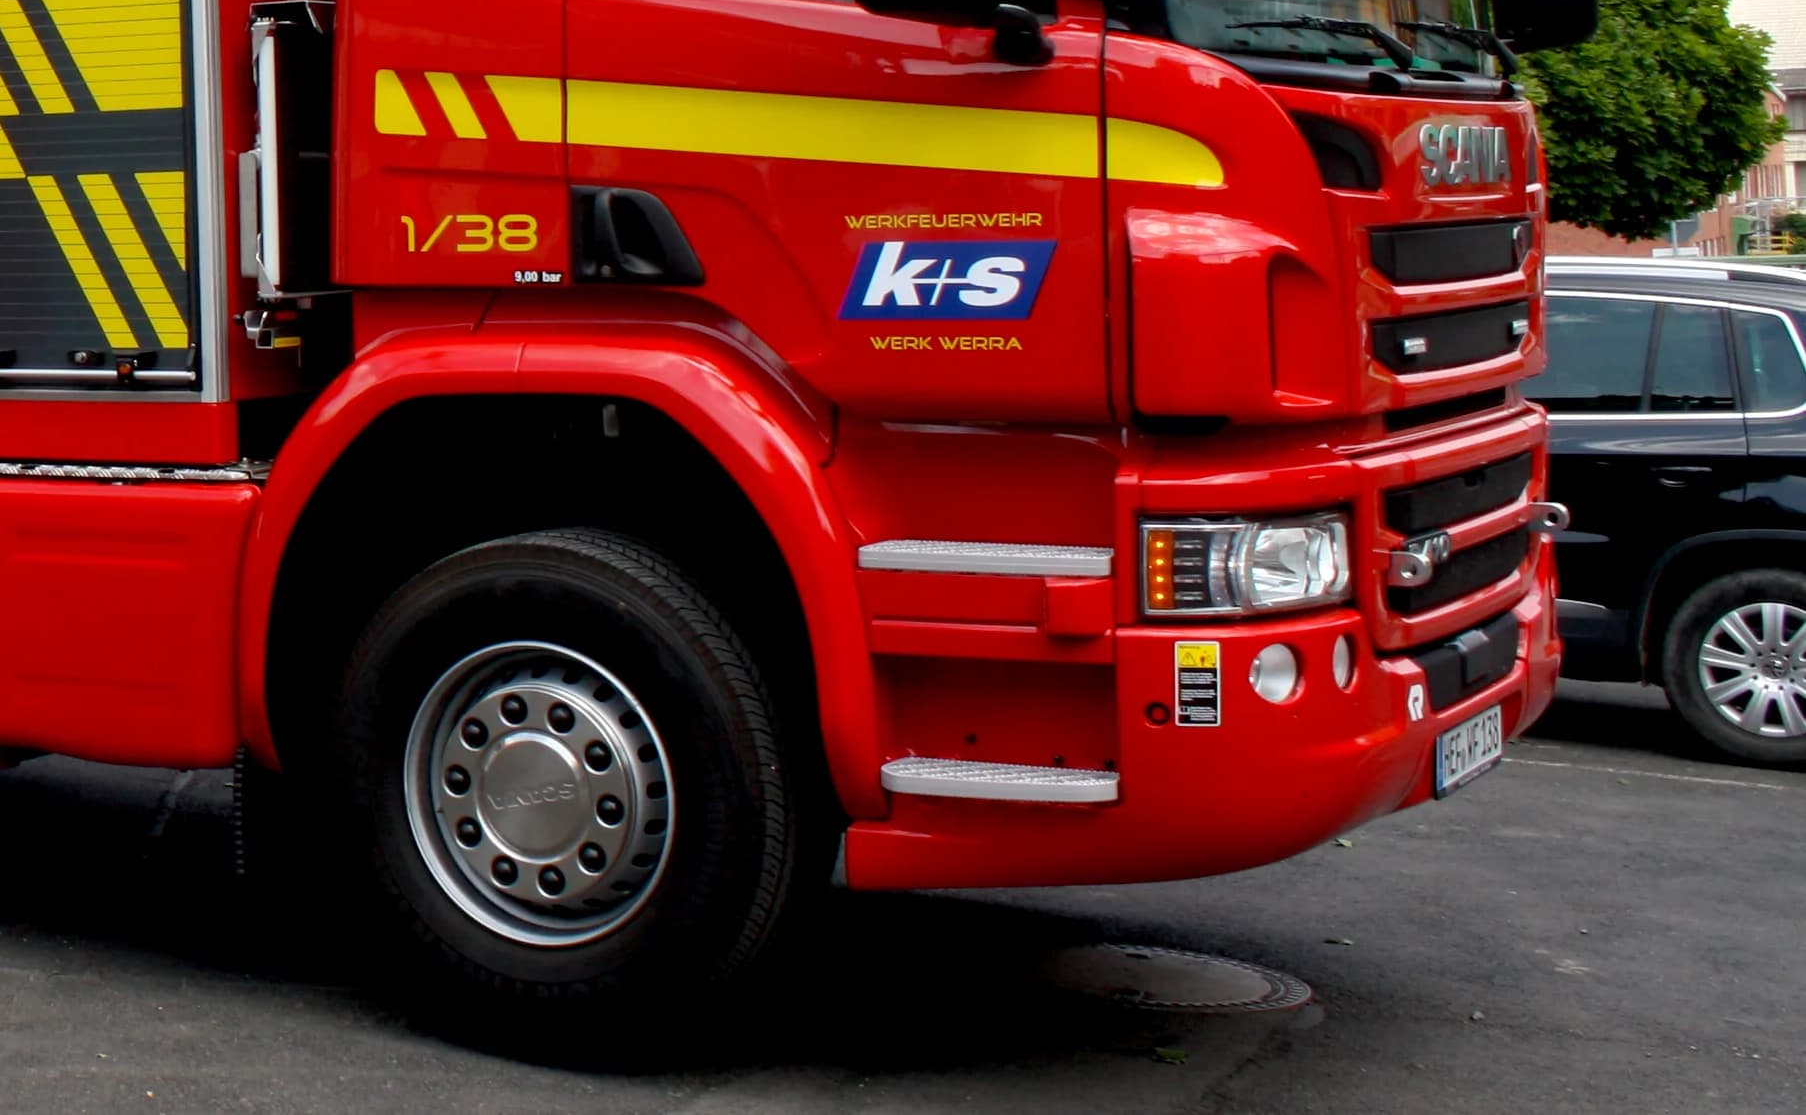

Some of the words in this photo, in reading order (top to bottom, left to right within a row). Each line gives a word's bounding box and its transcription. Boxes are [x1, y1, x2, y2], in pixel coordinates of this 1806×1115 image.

[1419, 123, 1511, 186] SCANIA
[401, 214, 538, 252] 1/38
[845, 213, 1042, 229] WERKFEUERWEHR
[514, 270, 538, 284] 9,00
[542, 270, 562, 283] bar
[870, 336, 933, 350] WERK
[938, 336, 1023, 350] WERRA
[1481, 711, 1500, 756] 138
